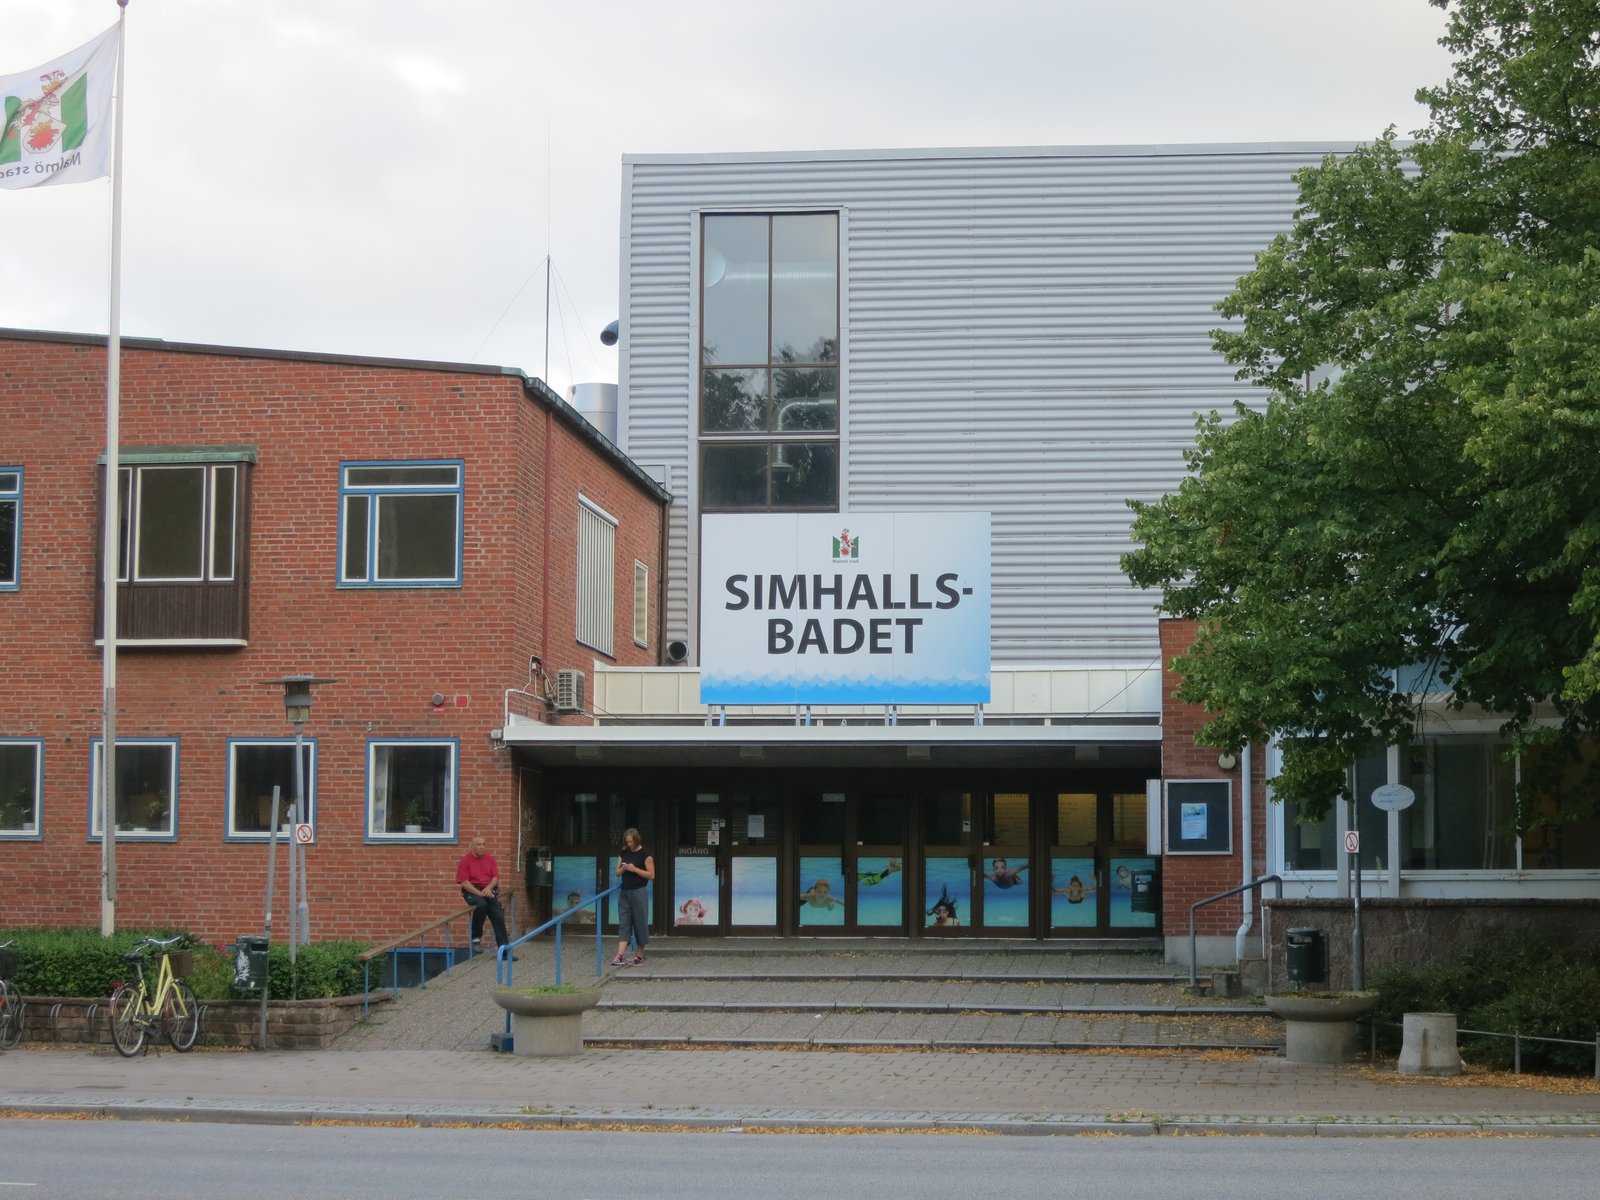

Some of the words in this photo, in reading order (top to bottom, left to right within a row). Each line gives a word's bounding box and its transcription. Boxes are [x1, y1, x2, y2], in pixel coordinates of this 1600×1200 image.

[725, 573, 973, 610] SIMHALLS-
[767, 618, 923, 654] BADET
[679, 846, 709, 855] INGÅNG
